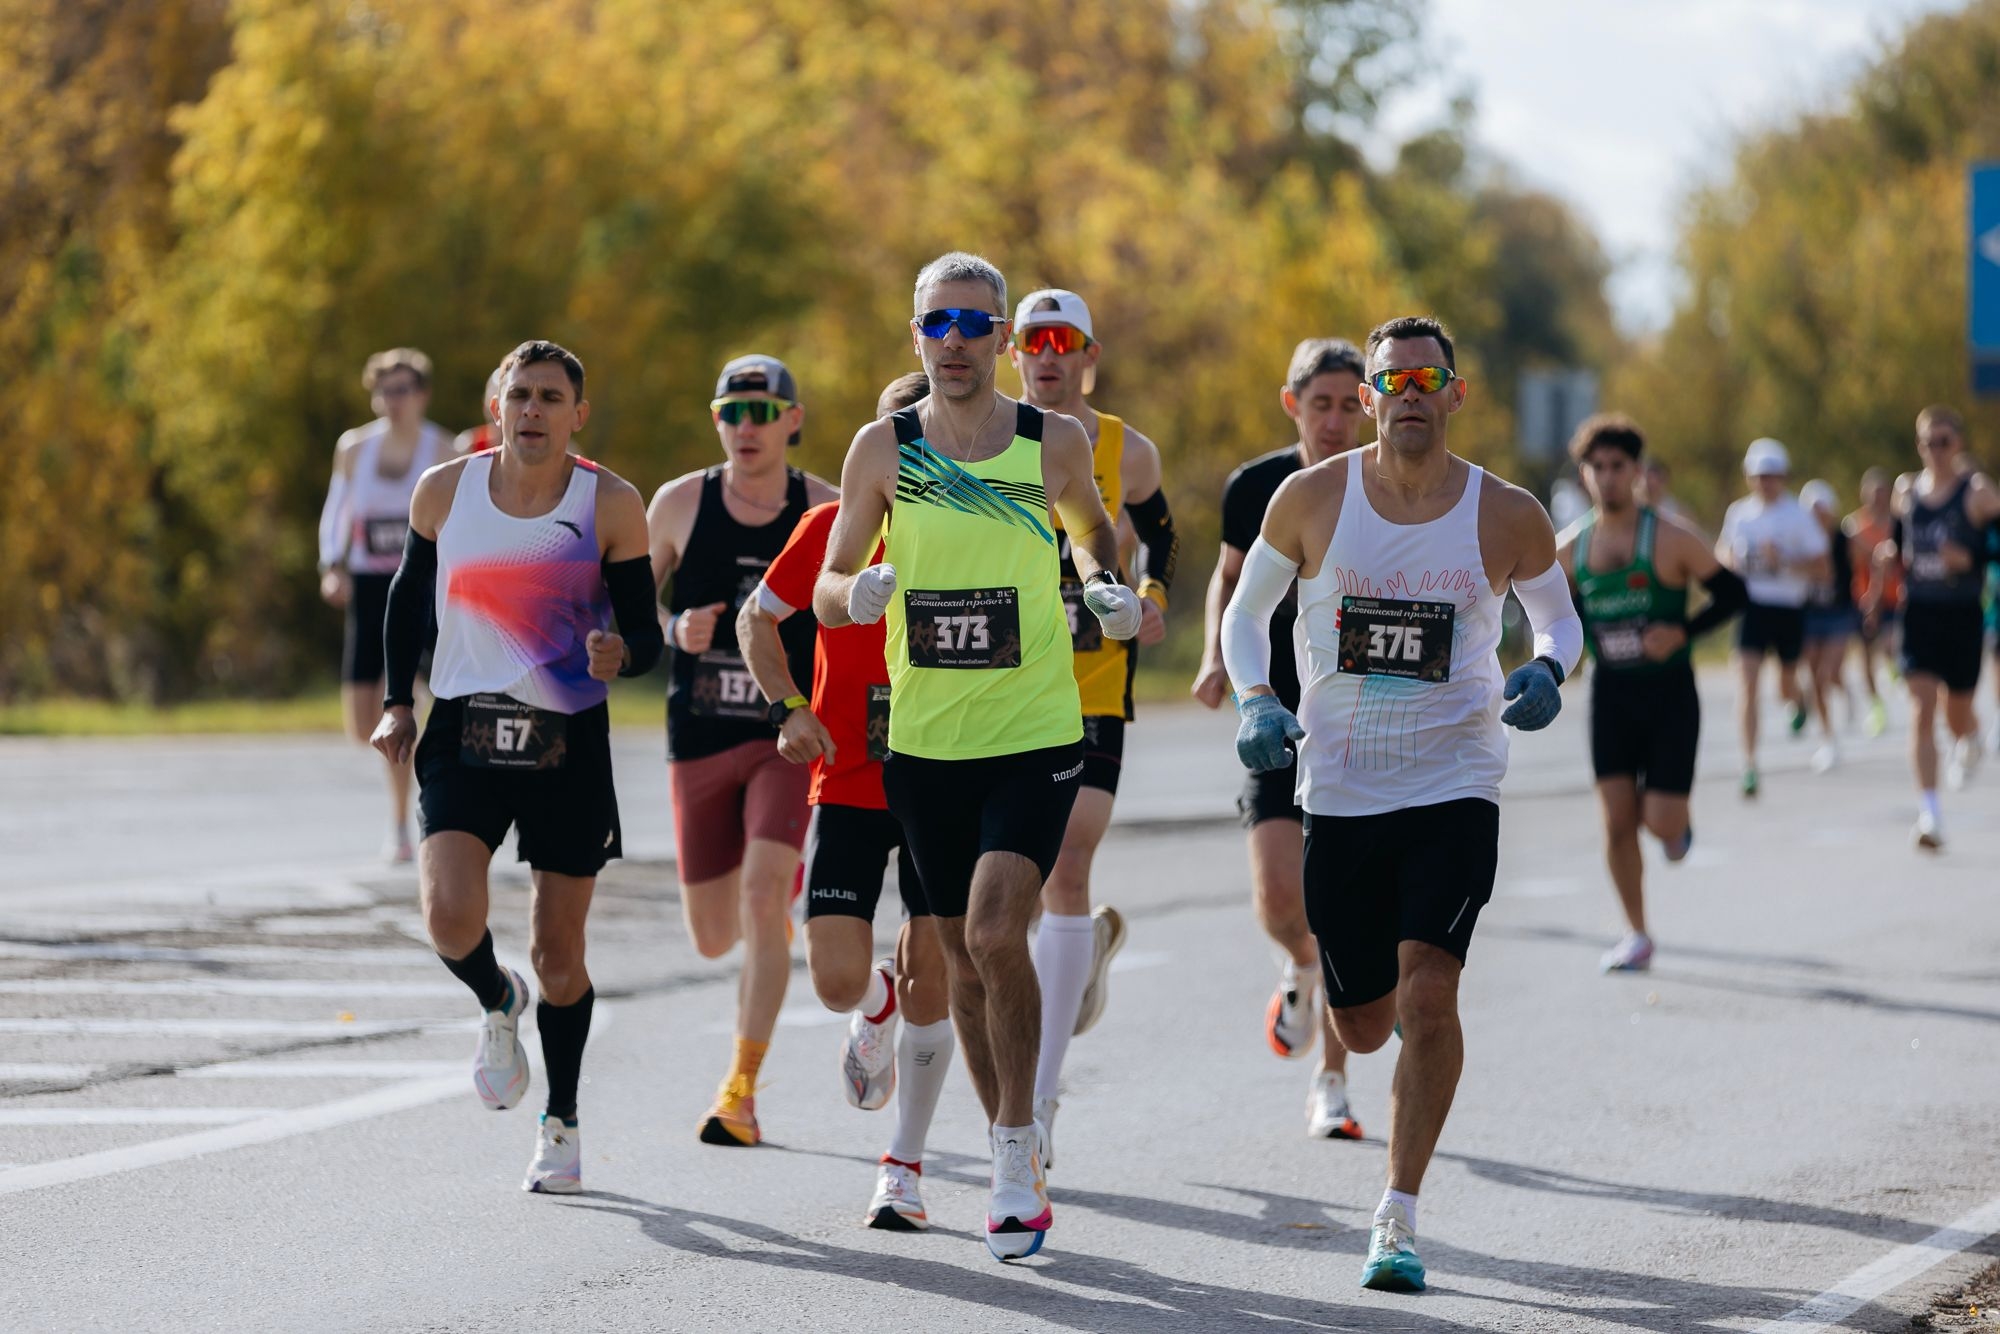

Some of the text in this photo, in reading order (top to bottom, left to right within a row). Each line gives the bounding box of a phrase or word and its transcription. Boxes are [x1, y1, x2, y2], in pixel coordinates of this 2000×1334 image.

[934, 616, 989, 649] 373
[1368, 624, 1423, 661] 376
[496, 718, 531, 751] 67
[812, 888, 857, 901] HUUB
